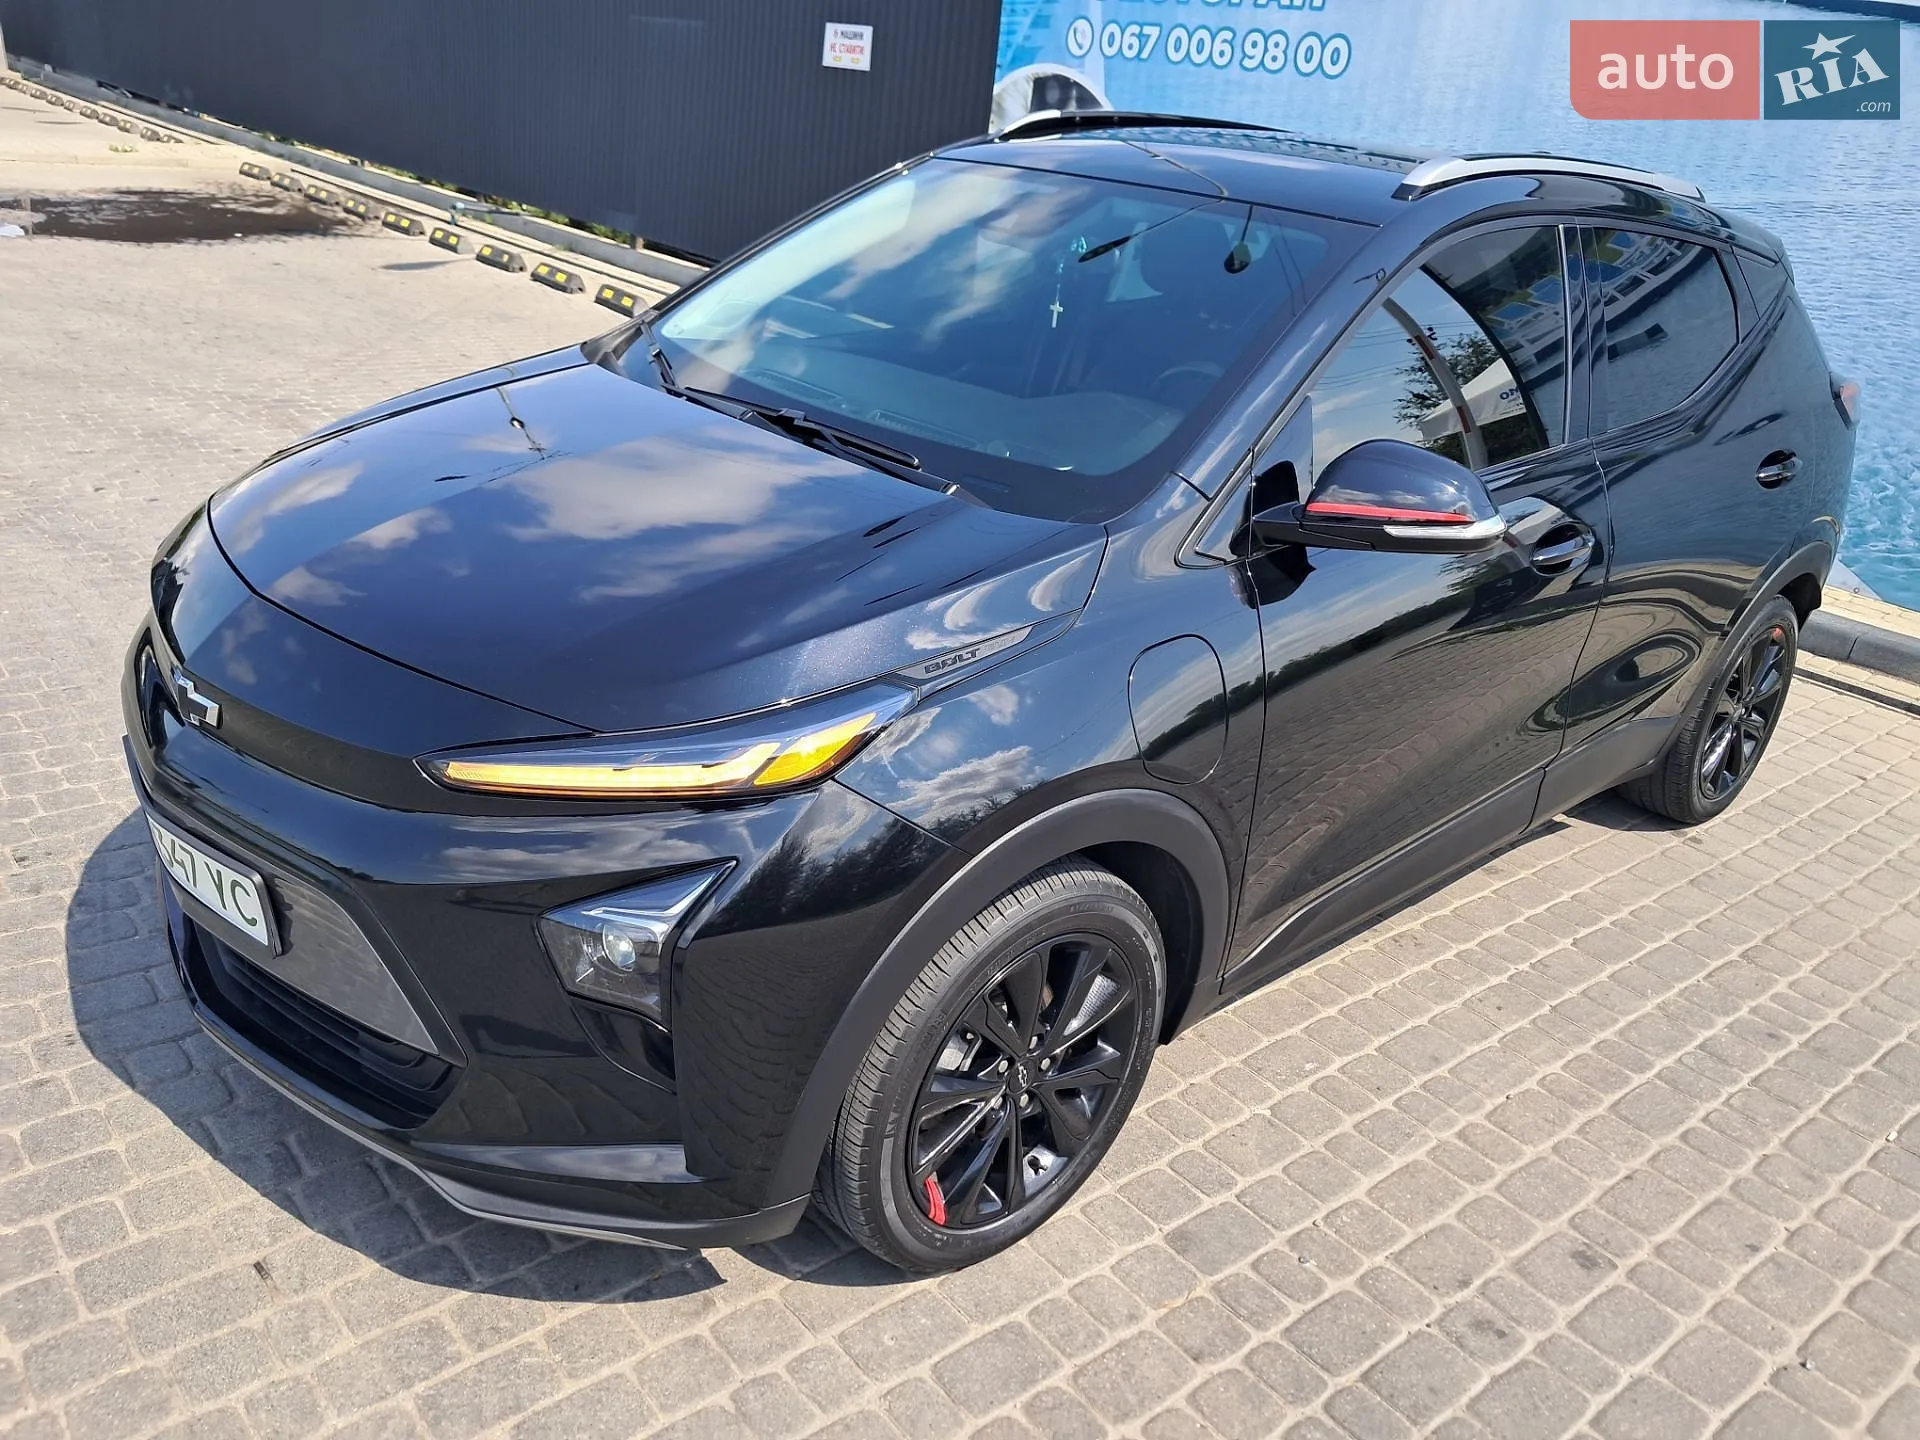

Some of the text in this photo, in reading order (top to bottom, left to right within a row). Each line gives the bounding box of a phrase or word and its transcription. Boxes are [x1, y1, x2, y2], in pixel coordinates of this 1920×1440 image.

[1100, 20, 1351, 79] 067 006 98 00
[923, 647, 981, 675] BOLT
[203, 860, 258, 927] YC
